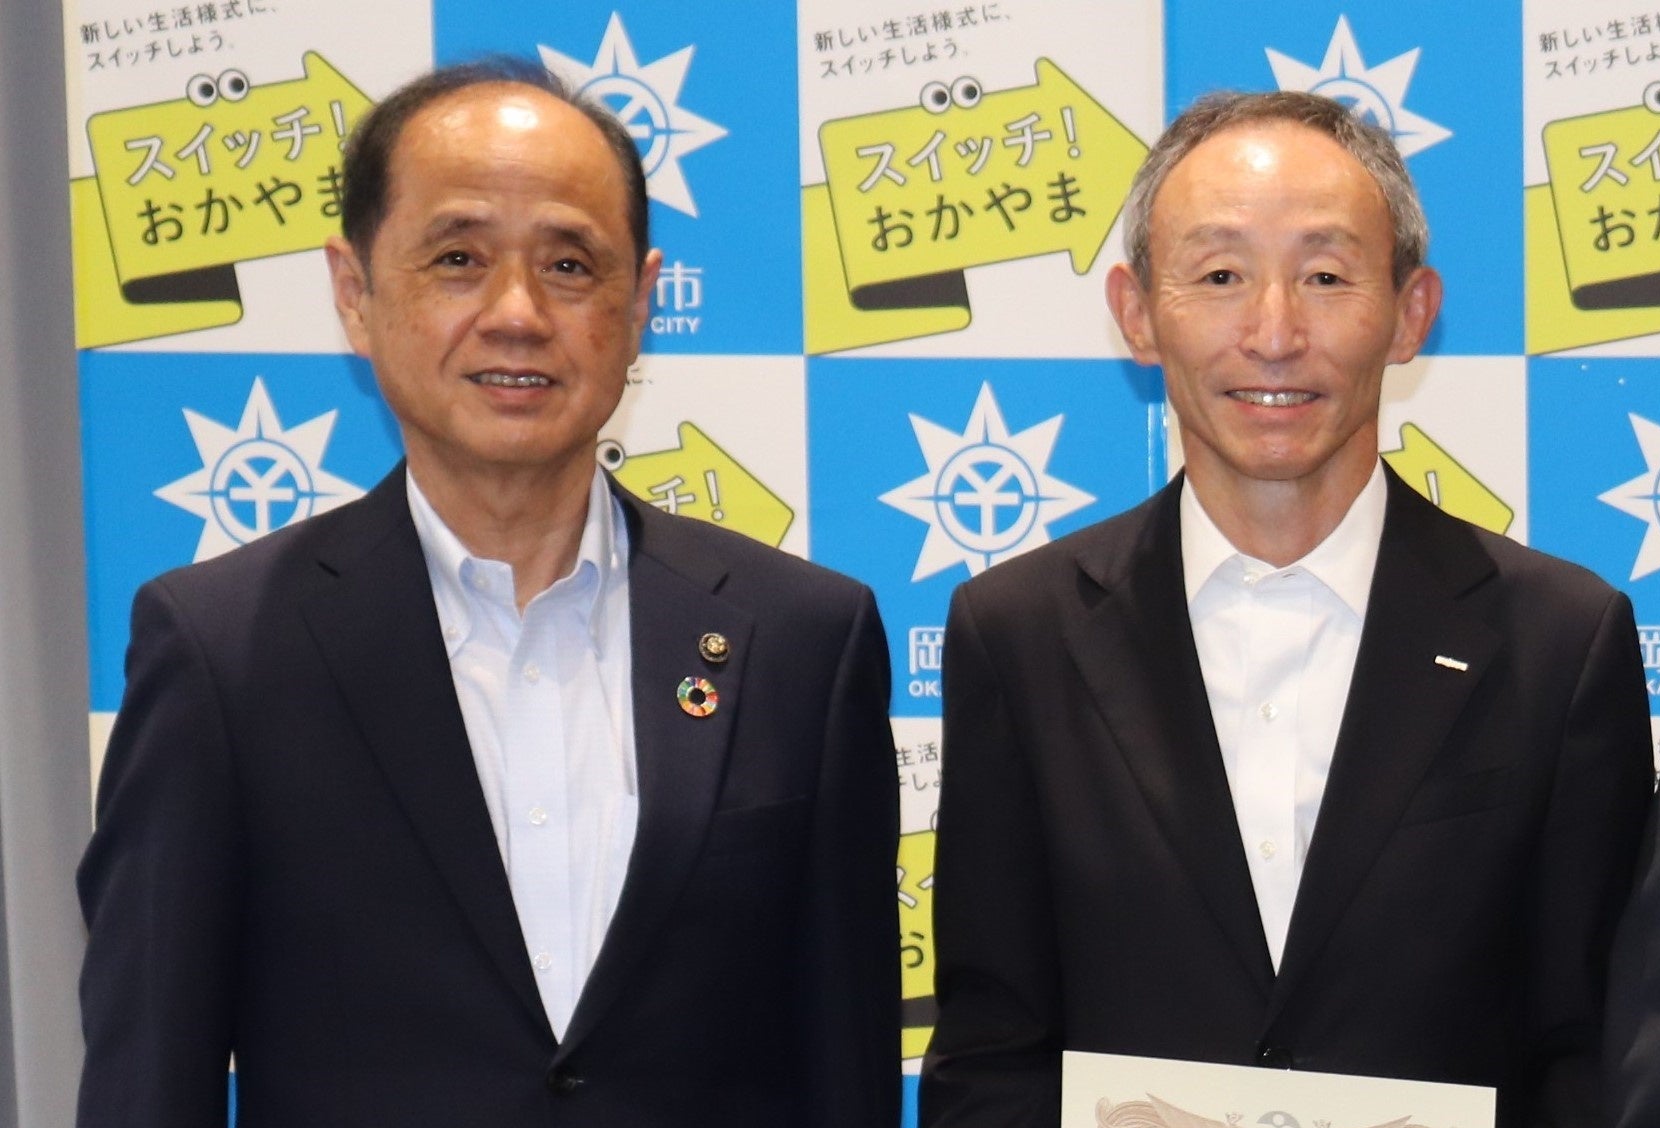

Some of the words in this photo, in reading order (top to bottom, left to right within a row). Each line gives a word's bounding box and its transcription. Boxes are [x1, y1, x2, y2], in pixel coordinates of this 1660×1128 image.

[813, 3, 1012, 52] 新しい生活様式に、
[855, 106, 1082, 193] スイッチ!
[868, 172, 1086, 252] おかやま
[650, 316, 700, 334] CITY
